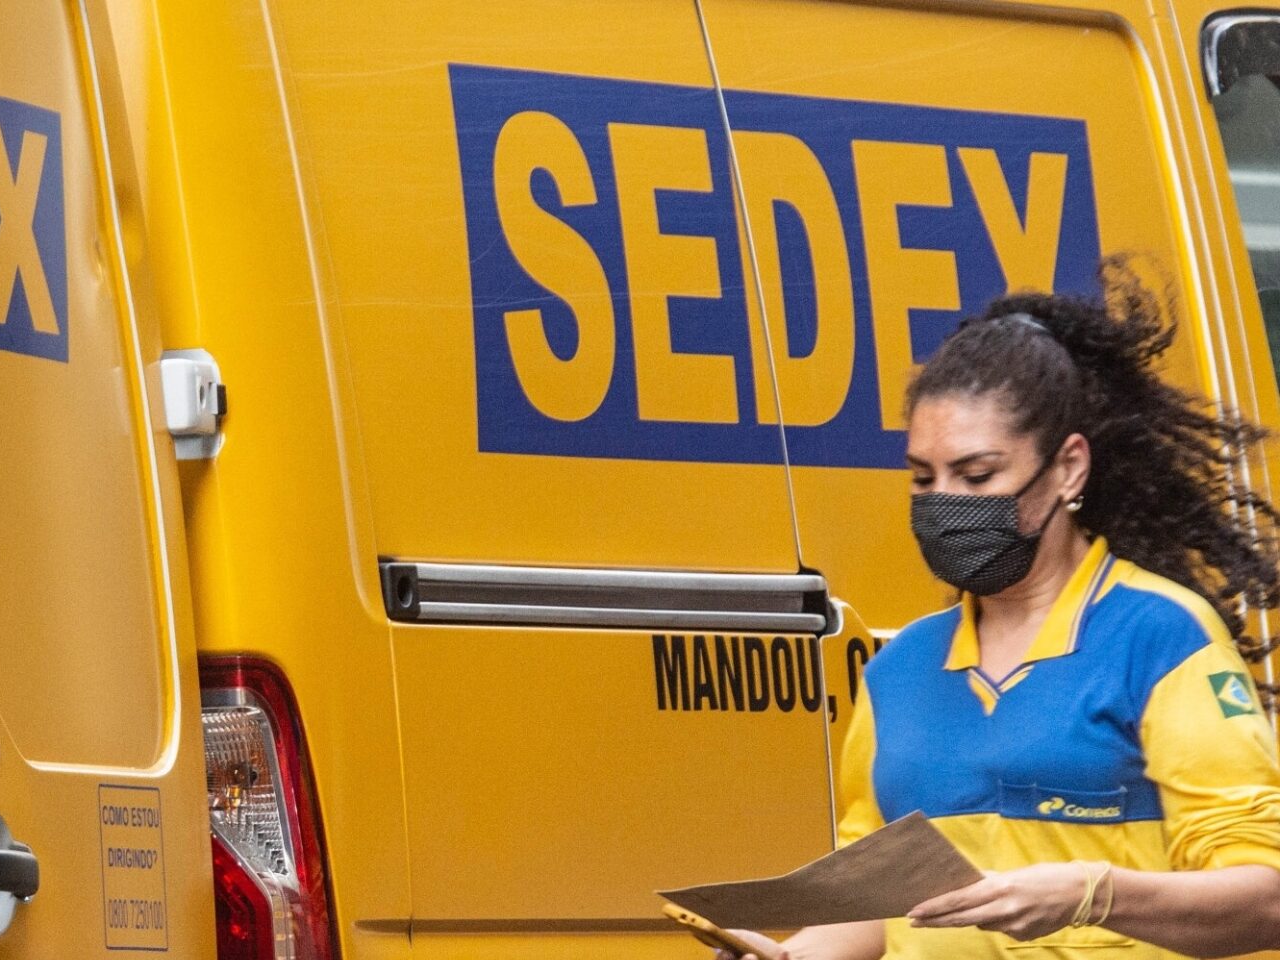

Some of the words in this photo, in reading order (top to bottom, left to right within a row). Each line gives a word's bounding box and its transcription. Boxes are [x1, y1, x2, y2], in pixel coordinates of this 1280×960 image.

[651, 634, 838, 723] MANDOU,
[101, 805, 129, 827] COMO
[131, 806, 160, 828] ESTOU
[107, 847, 158, 870] DIRIGINDO?
[108, 898, 129, 929] 0800
[129, 899, 164, 930] 7250100
